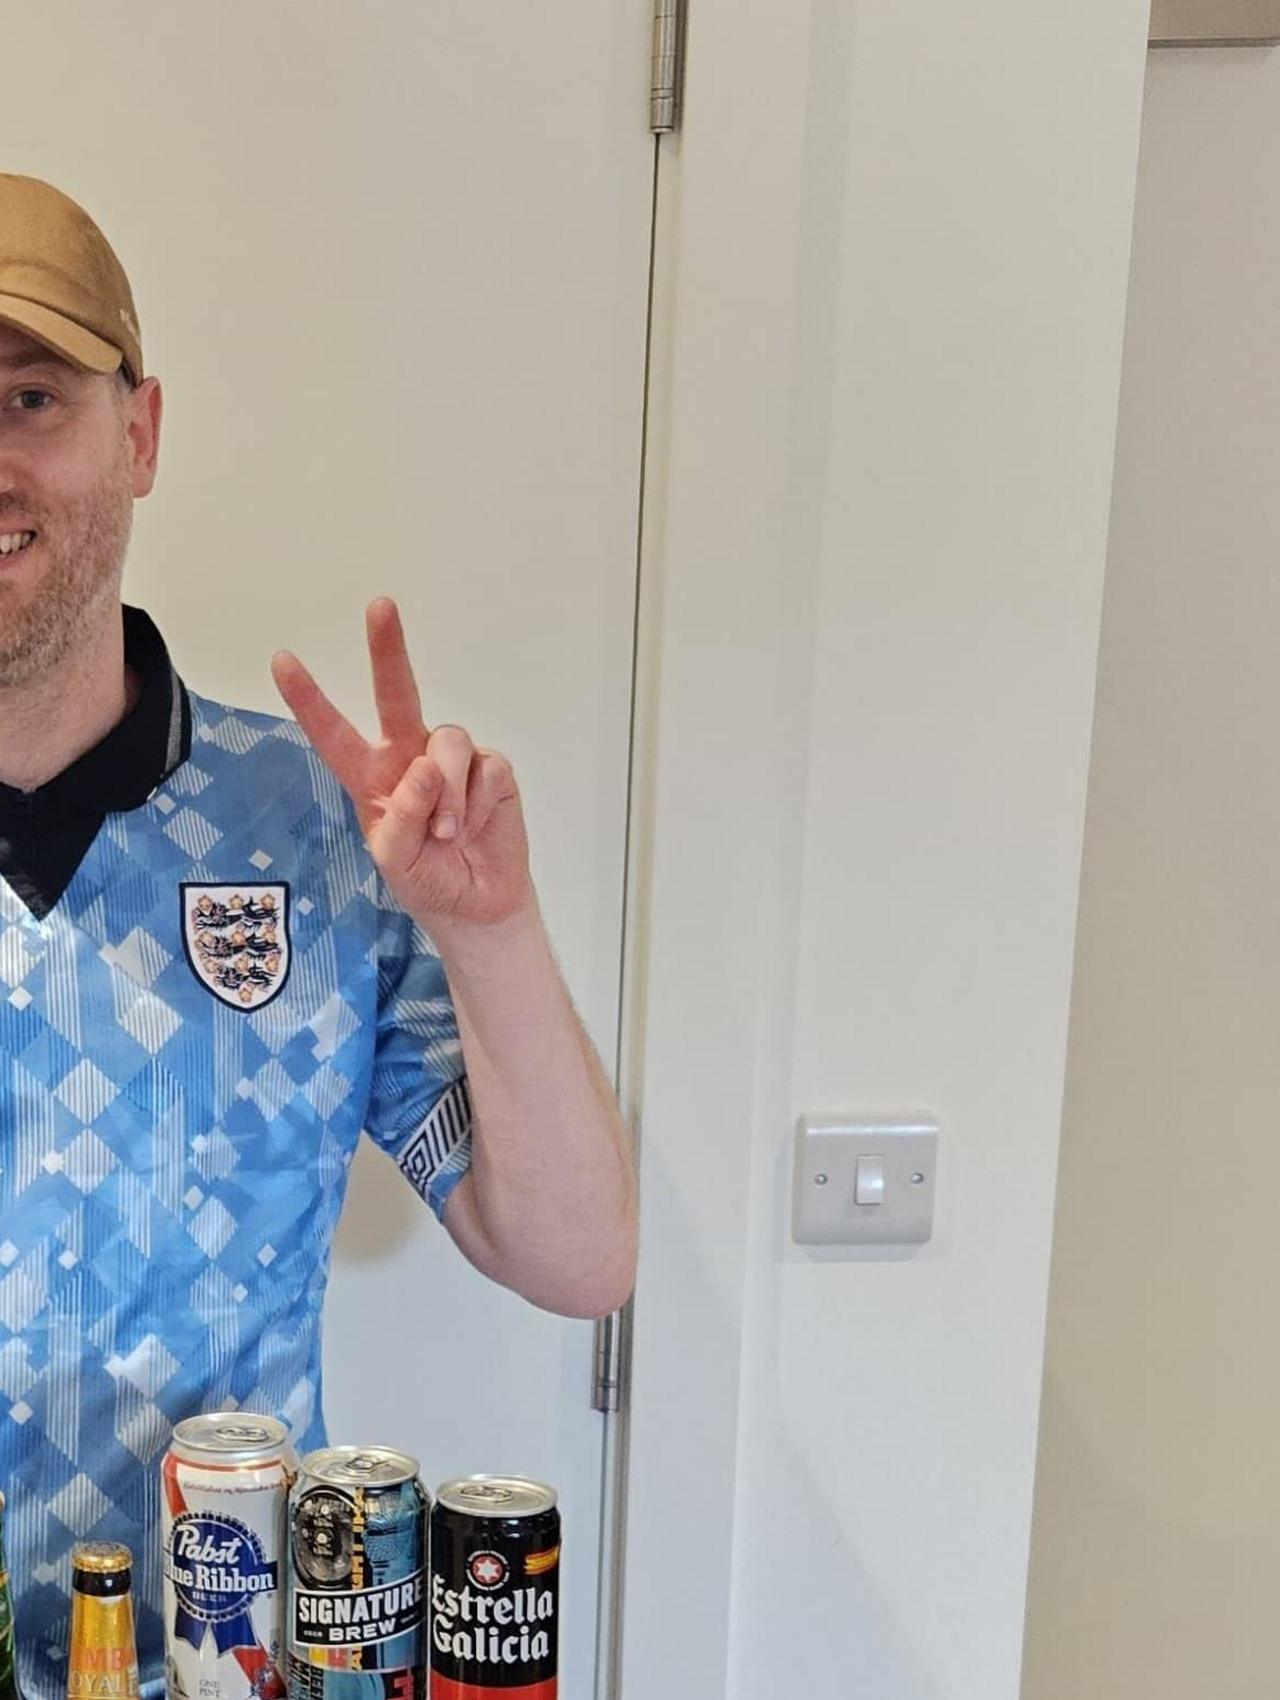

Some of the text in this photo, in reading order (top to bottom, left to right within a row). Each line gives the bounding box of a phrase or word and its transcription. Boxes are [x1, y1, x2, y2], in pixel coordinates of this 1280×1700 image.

[176, 1523, 242, 1565] Pabst
[195, 1566, 275, 1594] Ribbon
[432, 1574, 553, 1625] Estrella
[329, 1617, 396, 1642] BREW
[434, 1613, 549, 1664] Galicia
